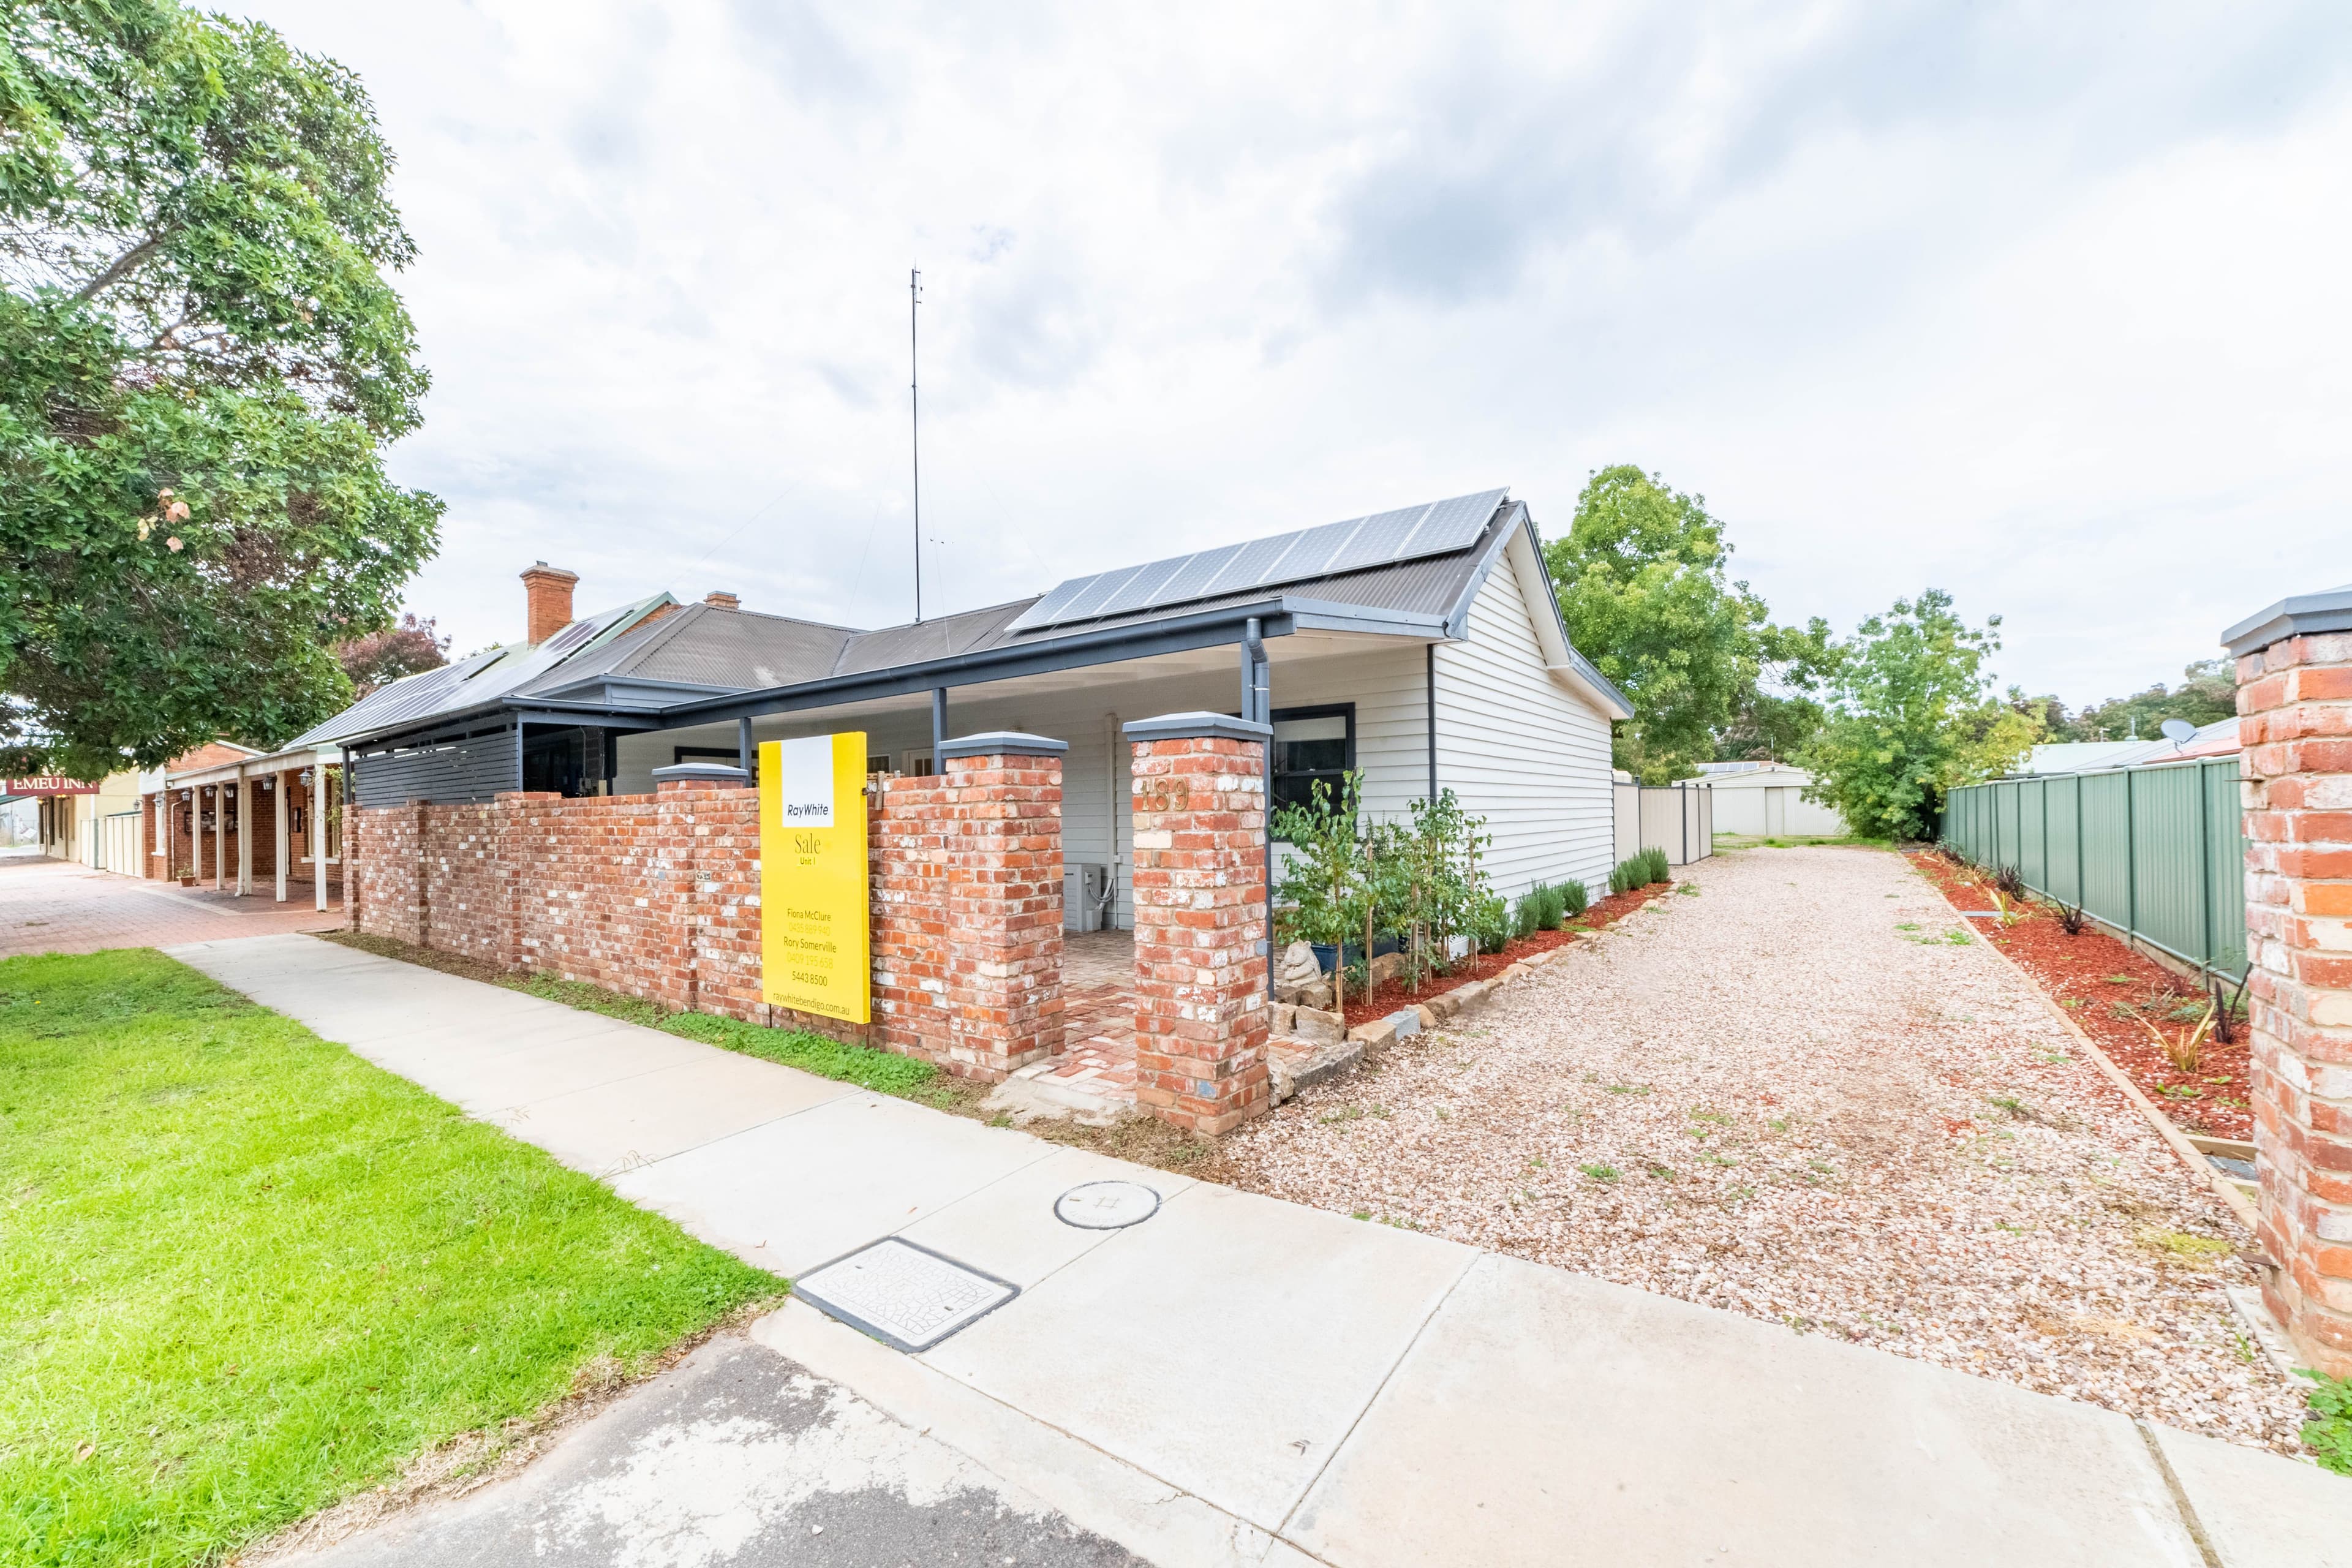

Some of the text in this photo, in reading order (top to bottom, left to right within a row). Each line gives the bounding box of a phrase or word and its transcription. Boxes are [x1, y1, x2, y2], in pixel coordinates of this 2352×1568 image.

[13, 777, 61, 790] EMEU
[1140, 778, 1189, 811] 189
[794, 832, 821, 854] Sale
[787, 908, 831, 921] Fiona McClure
[784, 936, 837, 953] Rory Somerville
[792, 971, 827, 986] 5443 8500
[773, 992, 850, 1016] raywhitebendigo.com.au
